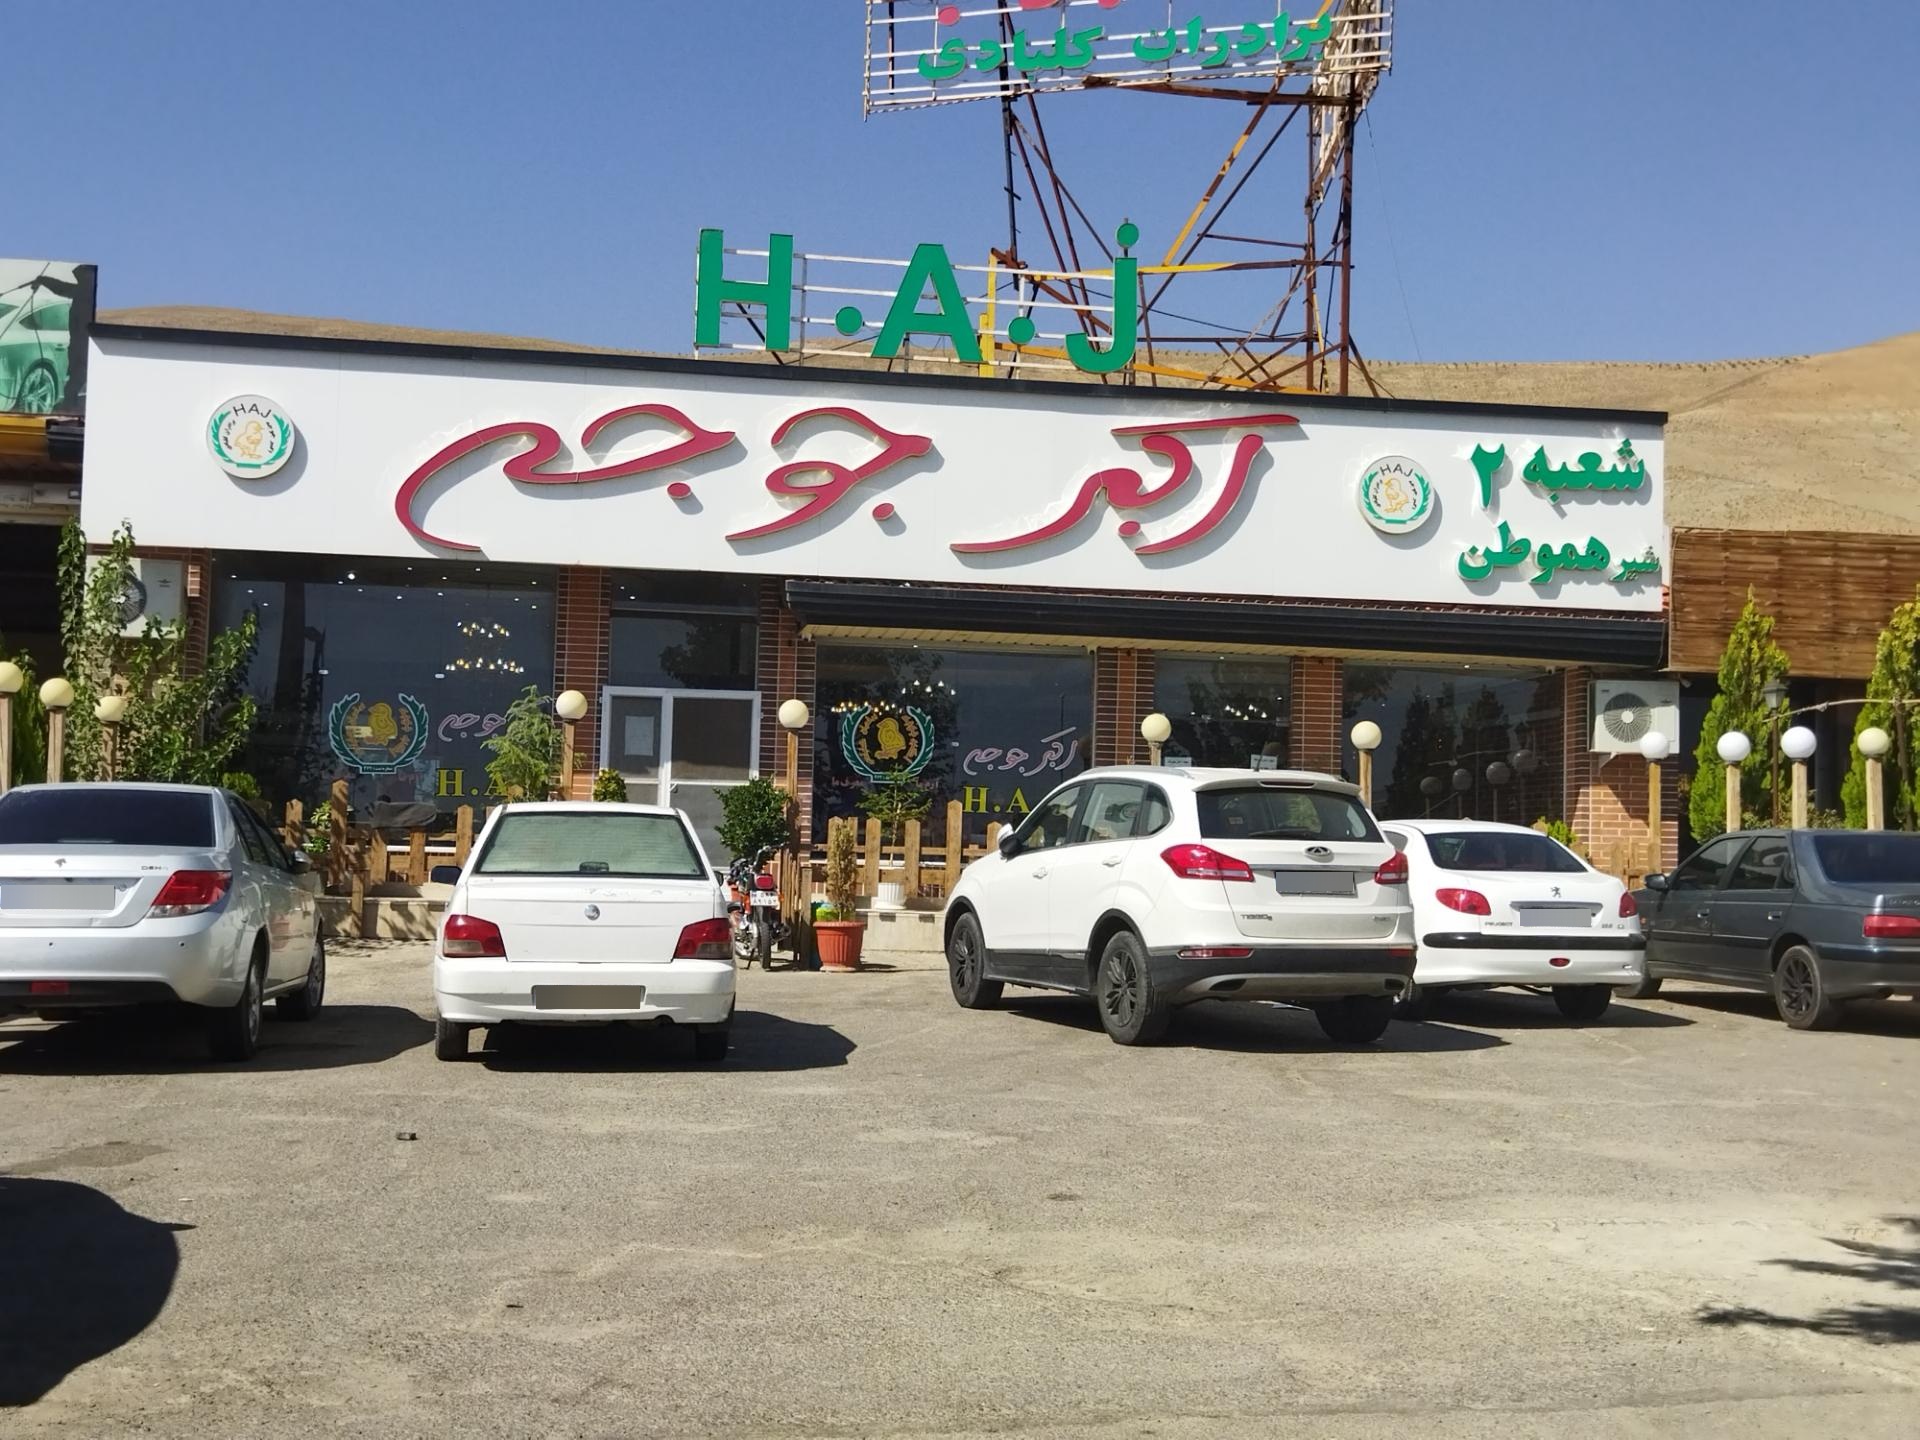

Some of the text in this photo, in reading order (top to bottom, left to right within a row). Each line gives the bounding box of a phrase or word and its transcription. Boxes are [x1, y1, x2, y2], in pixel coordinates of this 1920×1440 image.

[917, 26, 1105, 82] کلبادی
[1132, 11, 1332, 69] برادران
[232, 402, 272, 419] HAJ
[950, 413, 1298, 555] اکبر
[1379, 463, 1414, 478] HAJ
[1469, 442, 1506, 508] ۲
[1521, 437, 1646, 505] شعبه
[1457, 520, 1661, 585] شیر هموطن
[1022, 726, 1079, 777] اکبر
